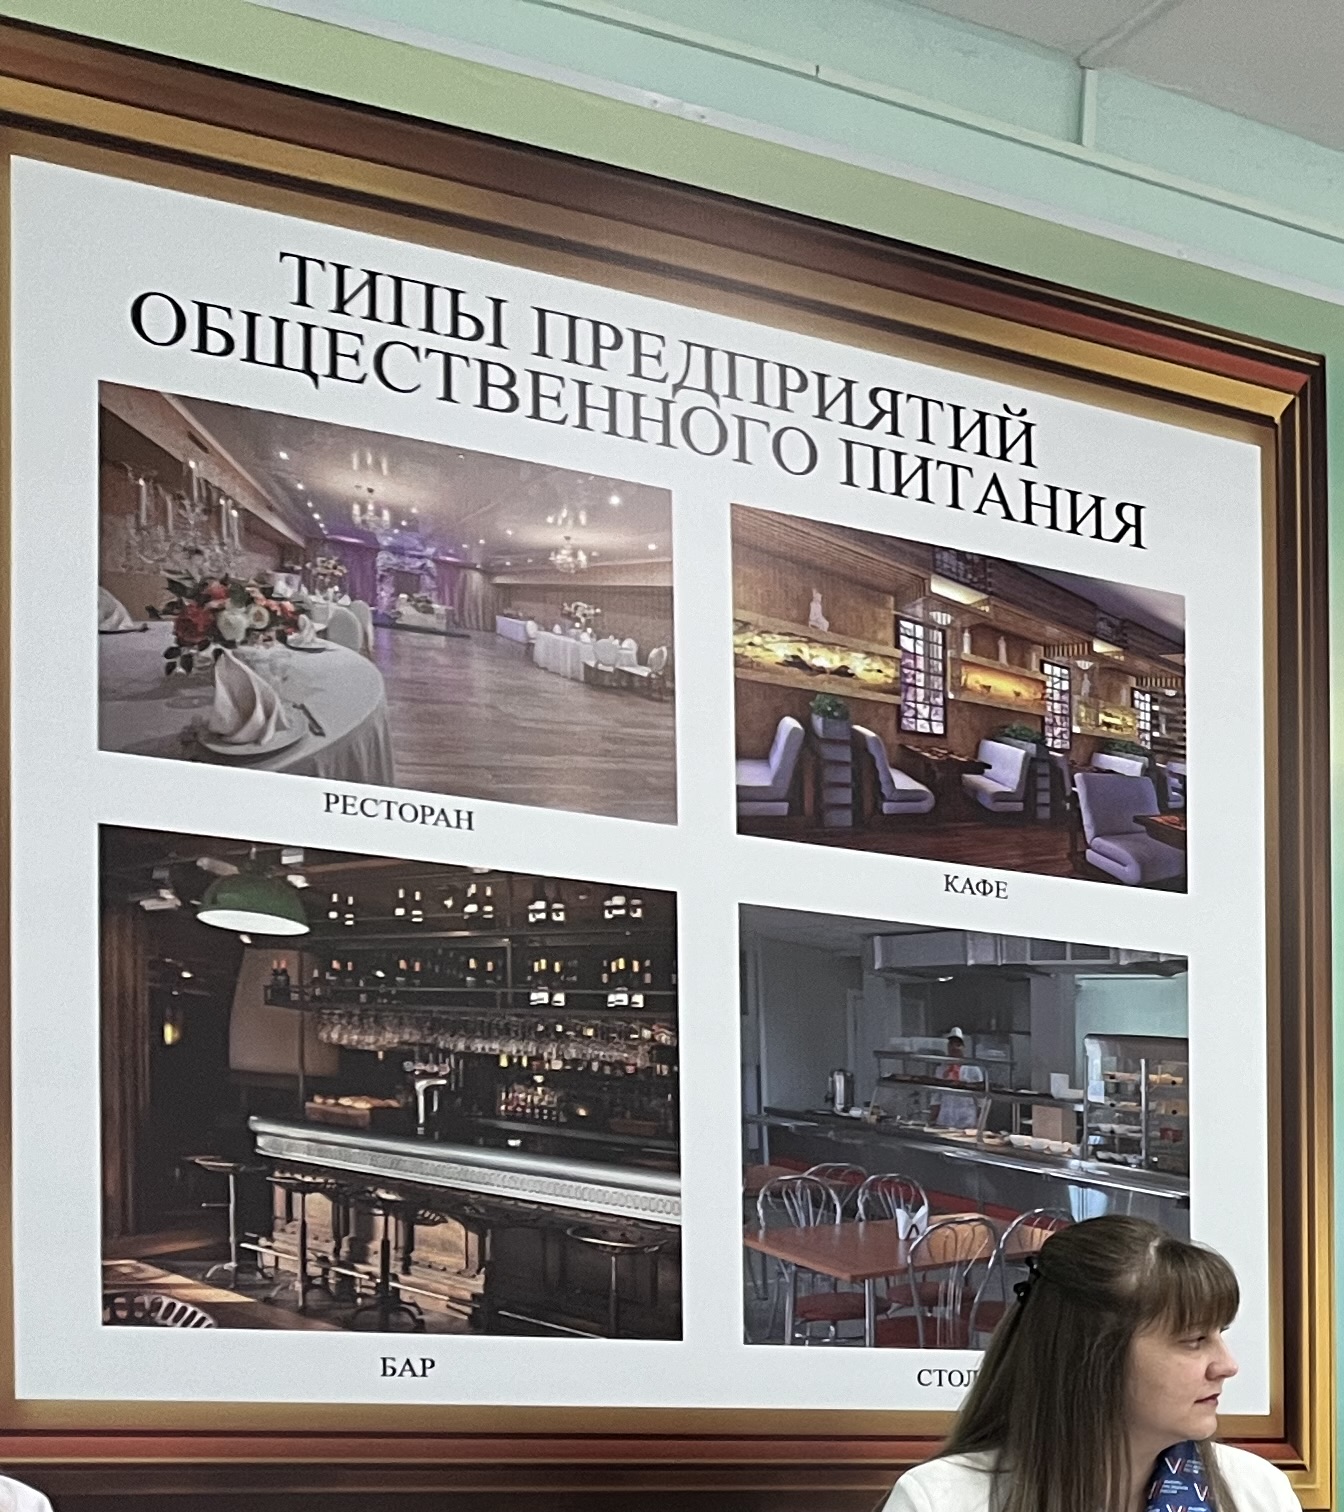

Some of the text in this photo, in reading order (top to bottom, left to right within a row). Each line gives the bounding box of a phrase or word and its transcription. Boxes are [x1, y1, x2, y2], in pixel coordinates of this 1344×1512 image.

[278, 250, 1039, 469] ТИПЫ ПРЕДПРИЯТИЙ
[130, 291, 1148, 550] ОБЩЕСТВЕННОГО ПИТАНИЯ
[323, 792, 475, 831] РЕСТОРАН
[943, 874, 1009, 899] КАФЕ
[380, 1356, 436, 1377] БАР
[917, 1368, 979, 1387] СТОЛ
